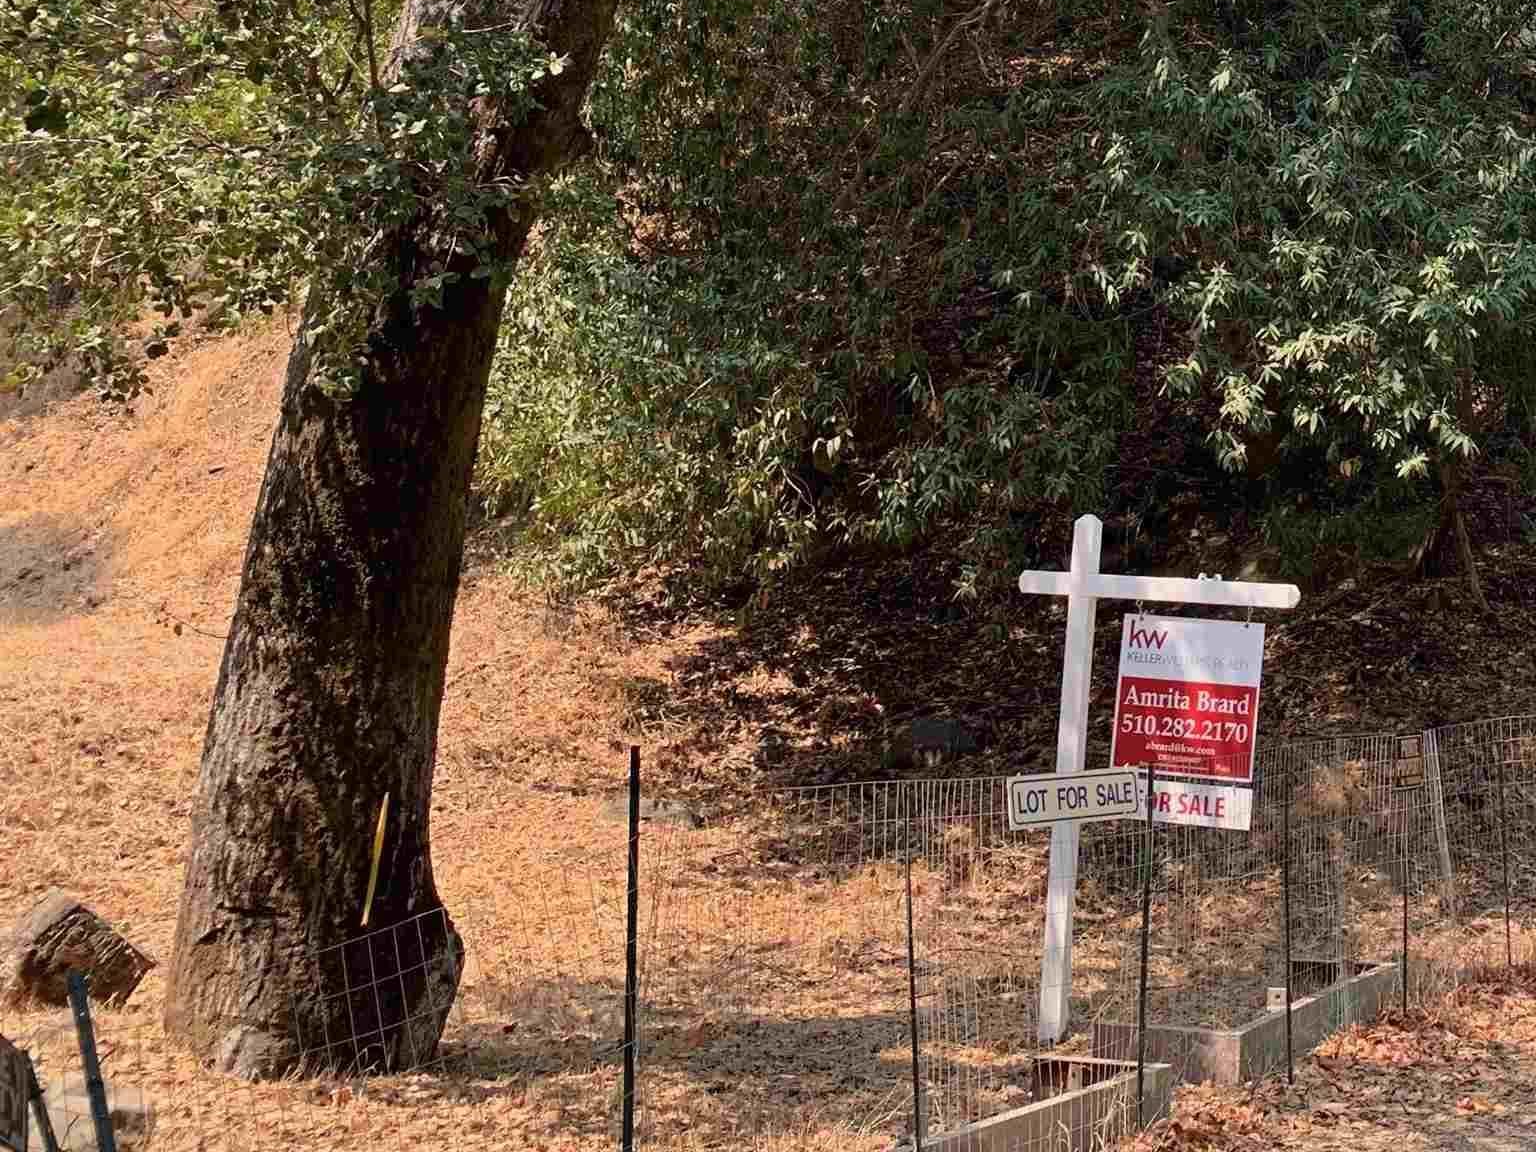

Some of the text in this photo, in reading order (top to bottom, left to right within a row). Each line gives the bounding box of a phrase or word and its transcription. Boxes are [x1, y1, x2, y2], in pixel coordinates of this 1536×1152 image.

[1128, 619, 1168, 649] kw
[1124, 684, 1249, 715] Amrita Brard
[1120, 713, 1248, 743] 510.282.2170
[1016, 782, 1133, 814] LOT FOR SALE
[1177, 793, 1225, 817] SALE
